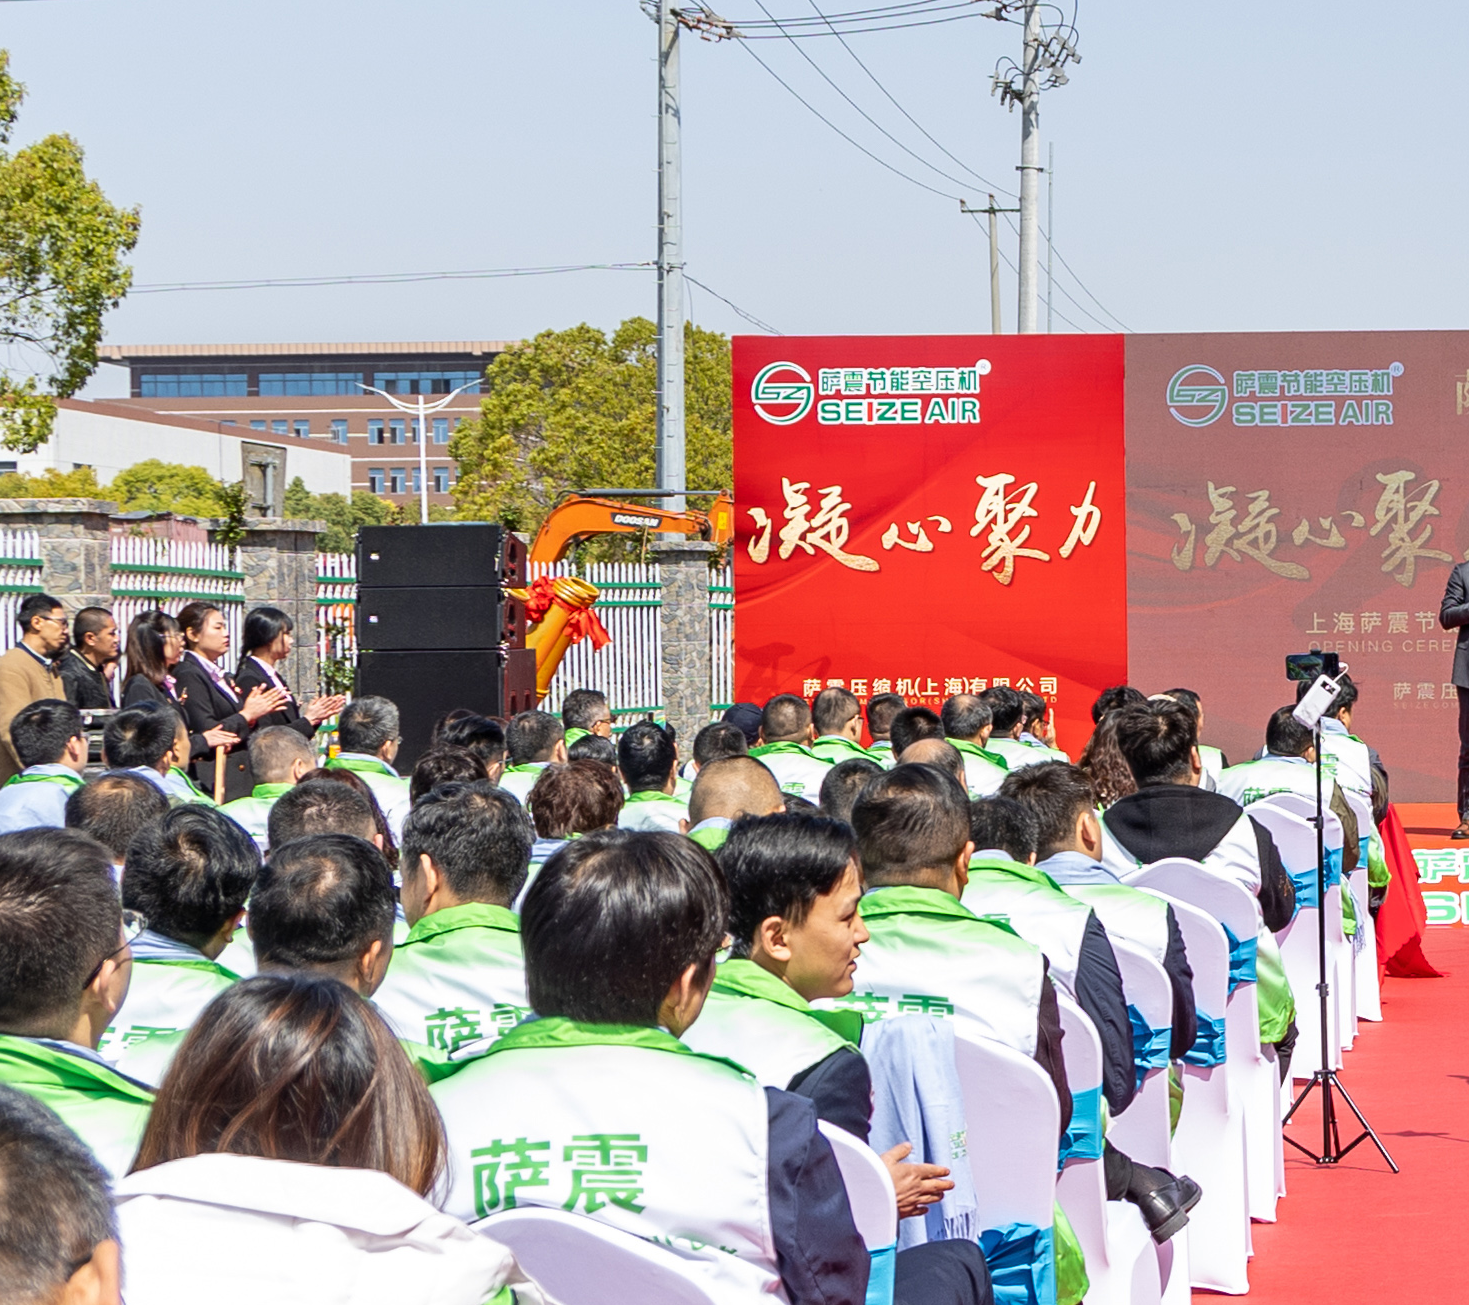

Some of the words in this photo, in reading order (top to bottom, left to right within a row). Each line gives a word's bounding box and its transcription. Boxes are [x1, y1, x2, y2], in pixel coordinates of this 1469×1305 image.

[819, 368, 979, 394] 萨震节能空压机
[1234, 370, 1392, 396] 萨震节能空压机
[819, 399, 921, 424] SEIZE
[925, 399, 980, 423] AIR
[1233, 401, 1335, 426] SEIZE
[1338, 400, 1393, 425] AIR
[745, 472, 1103, 586] 凝心聚力
[1306, 611, 1457, 635] 上海萨震节
[1308, 639, 1394, 653] OPENING
[469, 1132, 649, 1220] 萨震
